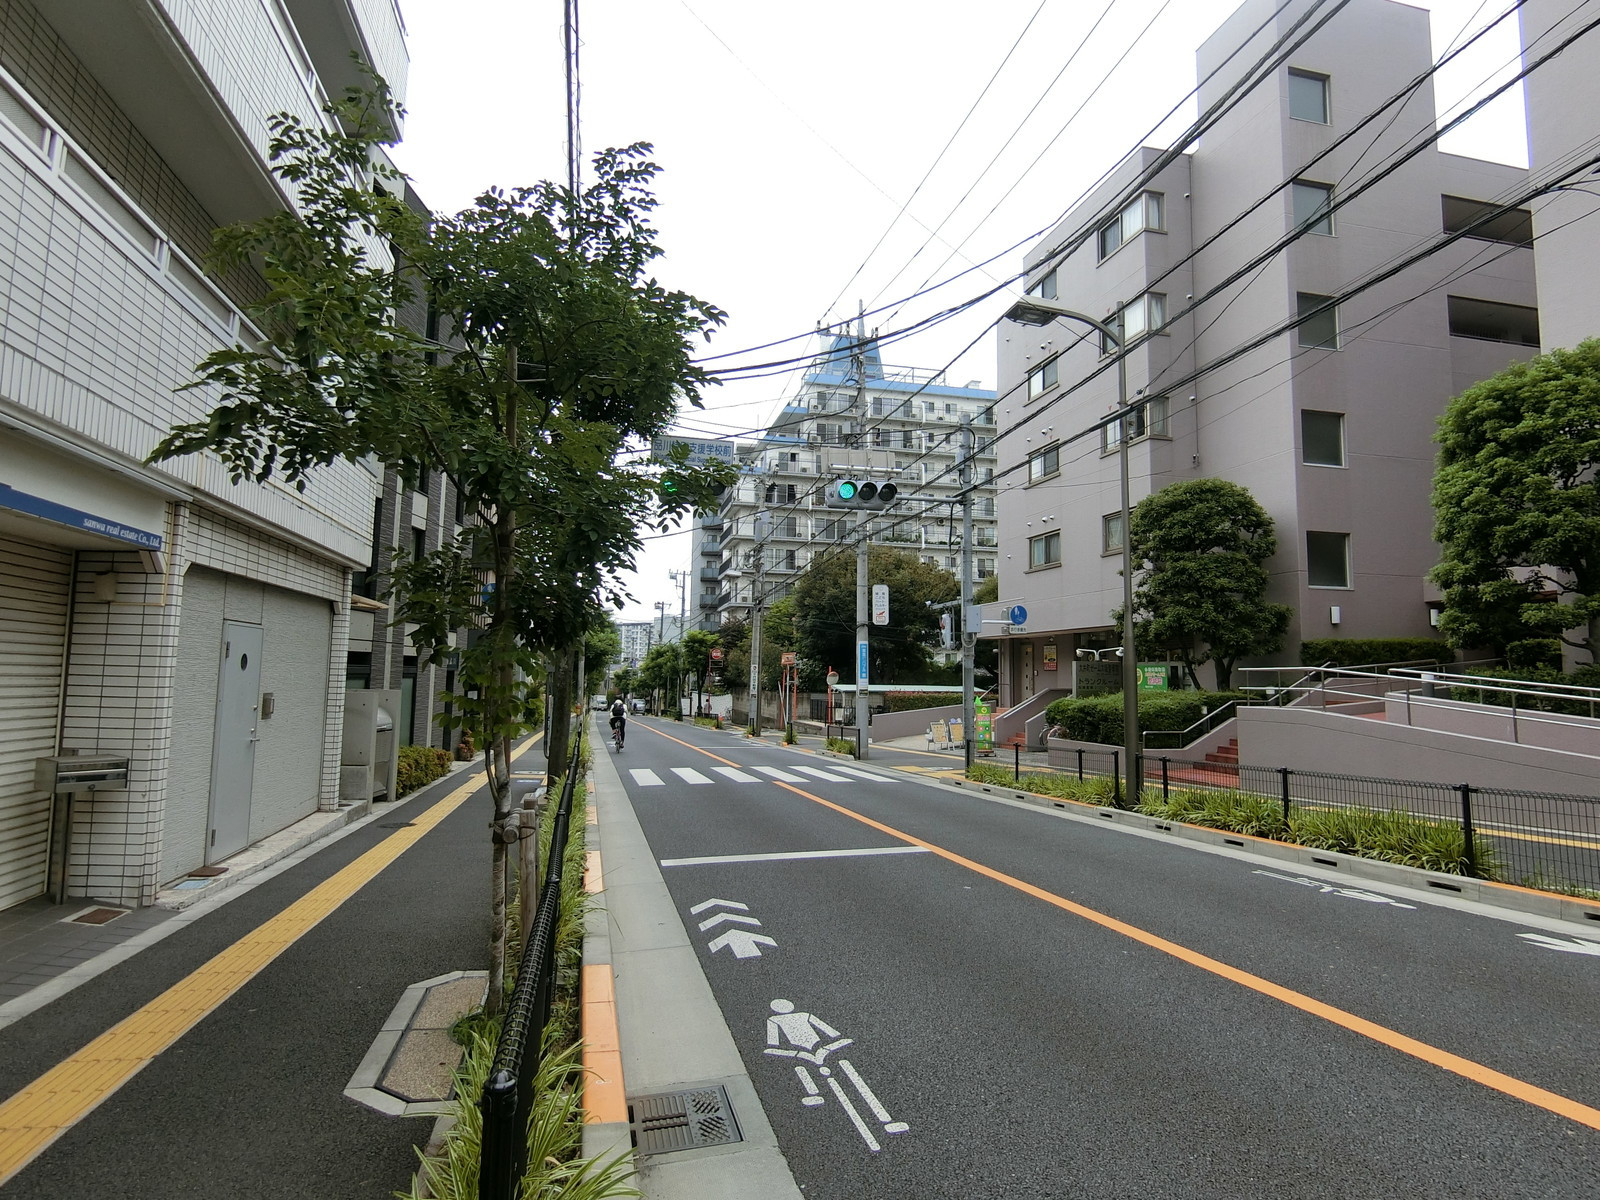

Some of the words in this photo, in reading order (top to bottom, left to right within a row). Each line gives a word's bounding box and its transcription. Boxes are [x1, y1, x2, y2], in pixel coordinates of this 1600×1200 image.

[653, 439, 732, 457] 品川支援学校前
[82, 518, 105, 531] sanwa
[106, 525, 120, 535] real
[120, 529, 138, 541] estate
[149, 536, 161, 547] Ltd.
